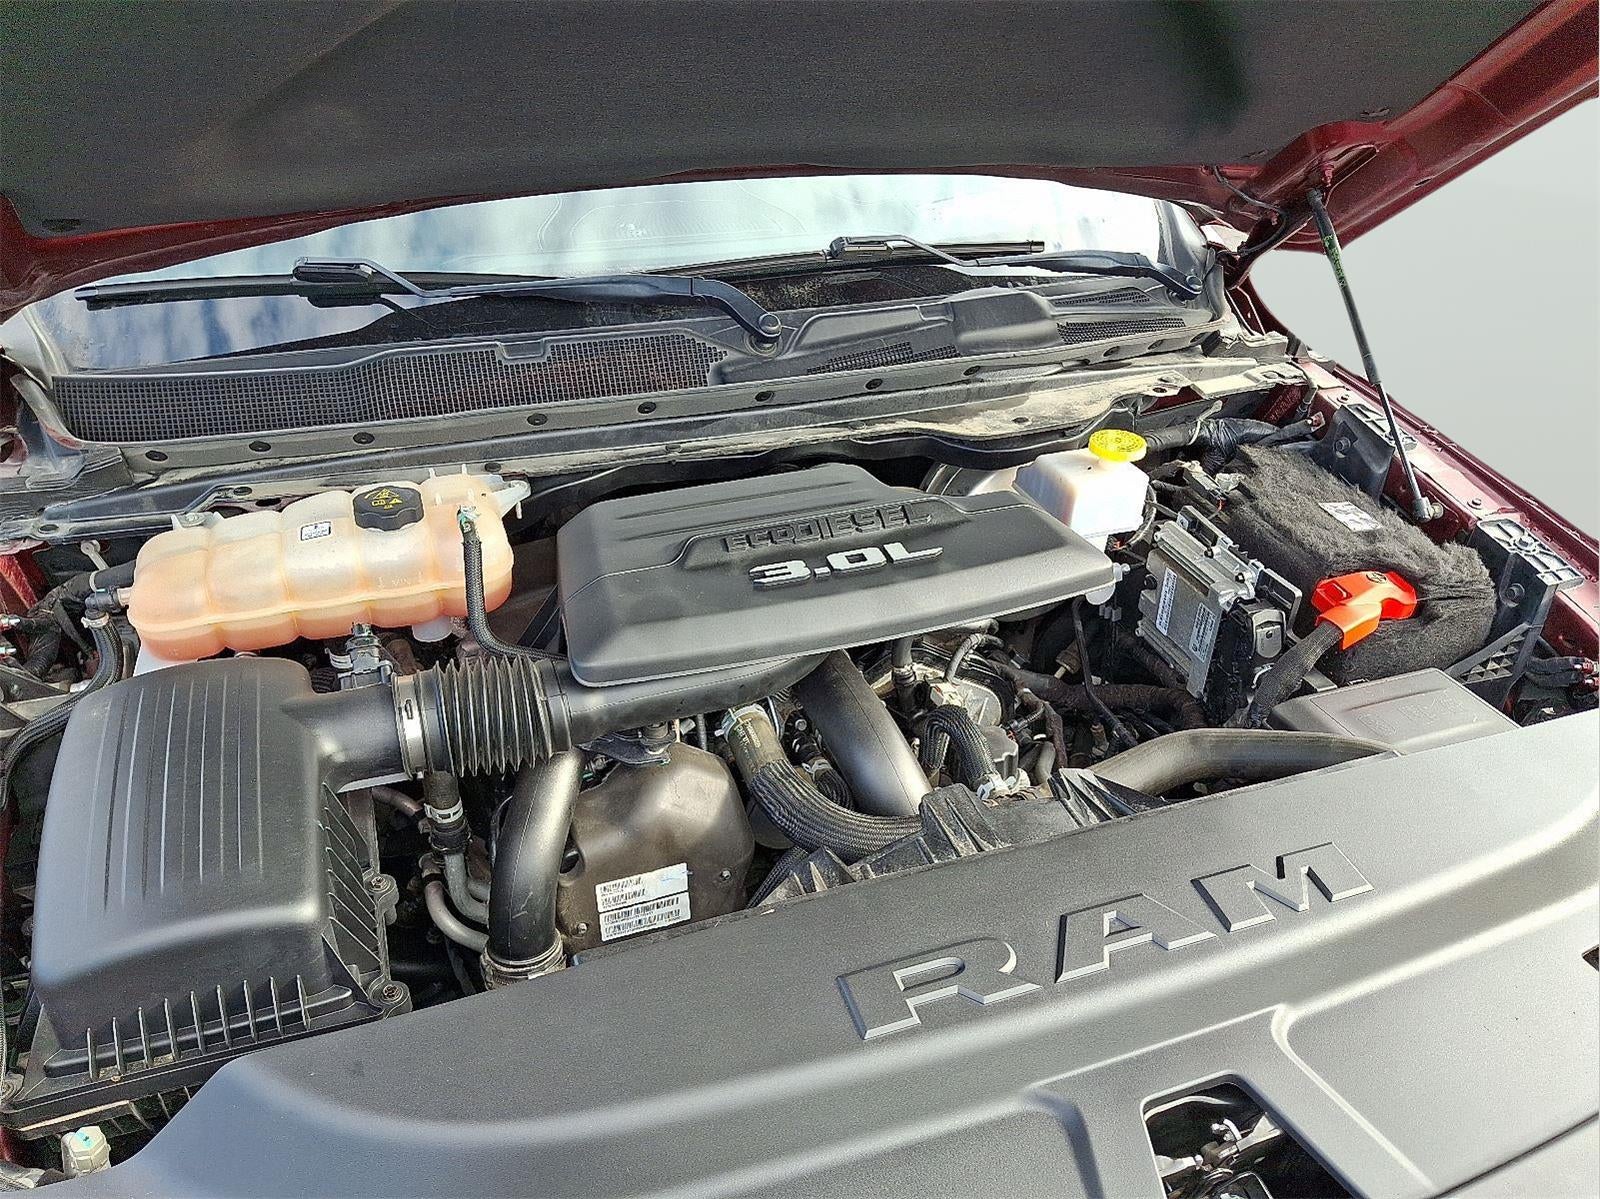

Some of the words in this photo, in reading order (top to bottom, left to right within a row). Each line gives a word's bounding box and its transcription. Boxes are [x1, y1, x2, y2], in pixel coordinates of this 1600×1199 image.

[722, 503, 932, 552] ECODIESEL
[749, 542, 943, 587] 3.0L
[836, 841, 1374, 1040] RAM
